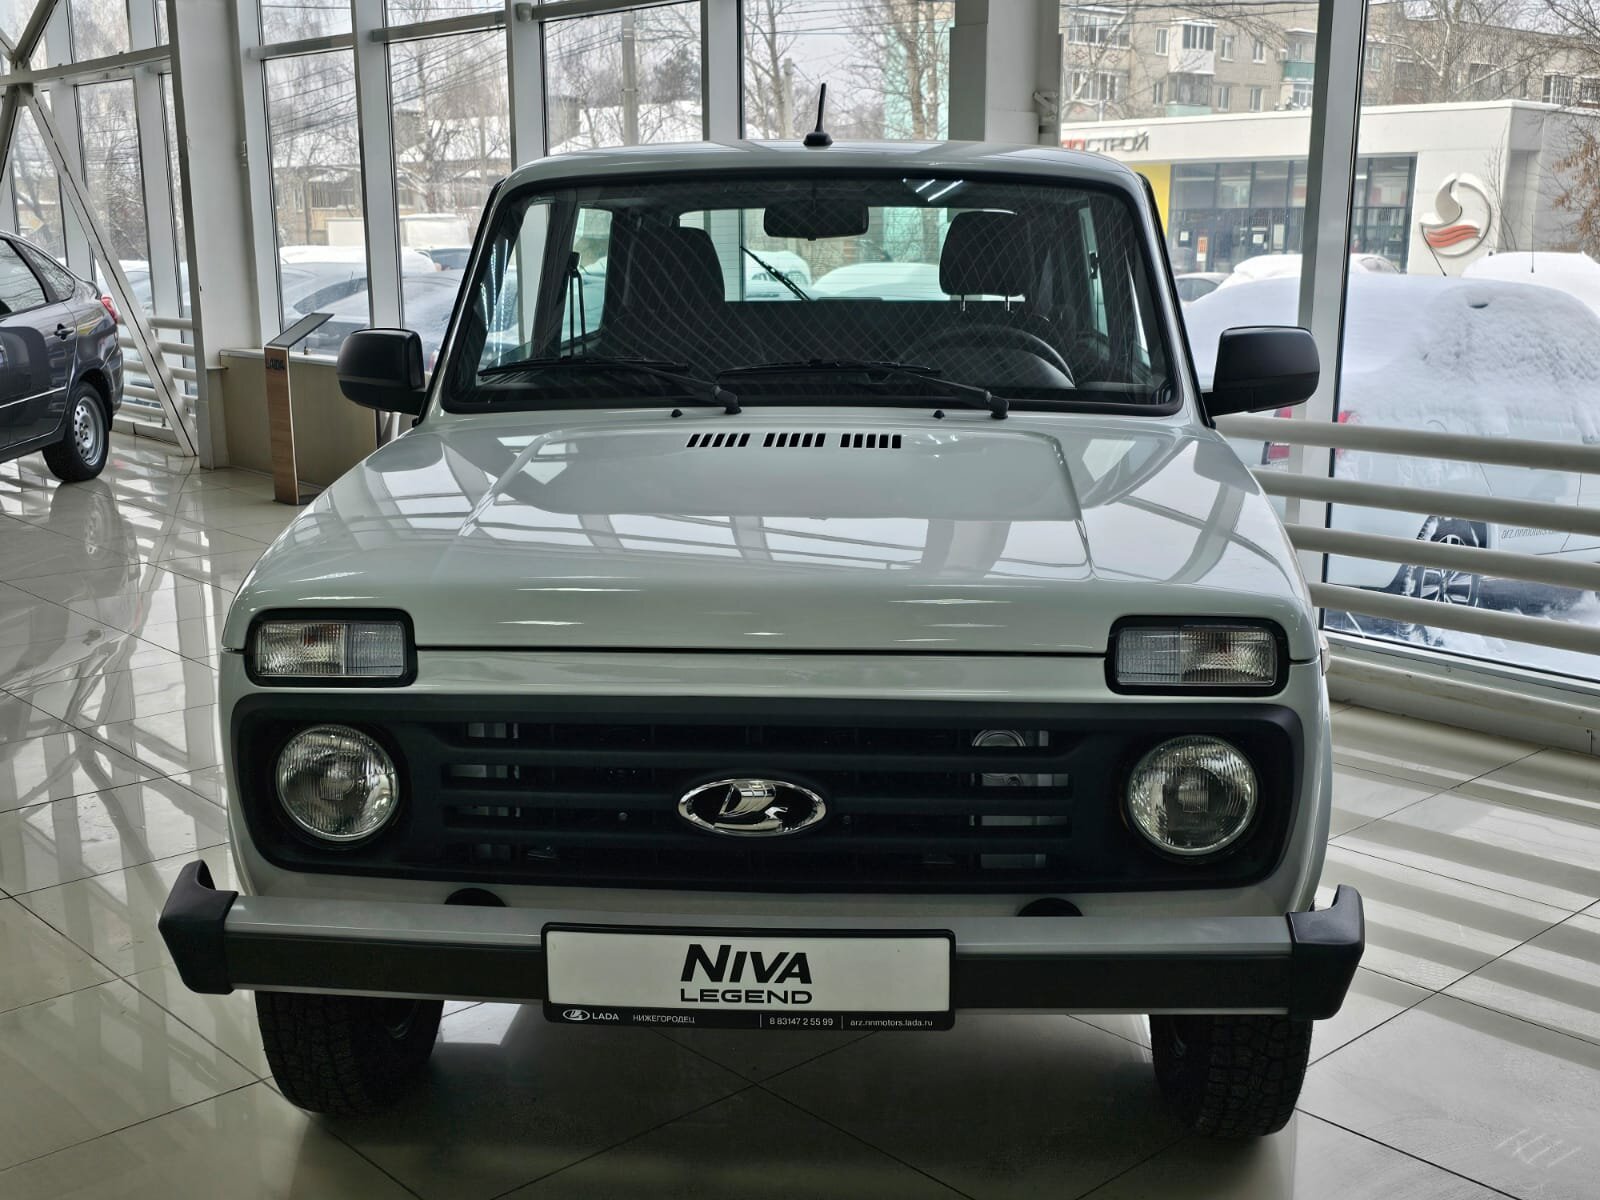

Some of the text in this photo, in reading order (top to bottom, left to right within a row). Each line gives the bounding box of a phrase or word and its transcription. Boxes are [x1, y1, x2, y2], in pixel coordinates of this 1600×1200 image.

[680, 944, 812, 984] NIVA
[680, 988, 813, 1004] LEGEND
[592, 1012, 620, 1021] LADA
[633, 1013, 696, 1024] НИЖЕГОРОДЕЦ
[850, 1018, 933, 1027] arz.nnmotors.lada.ru
